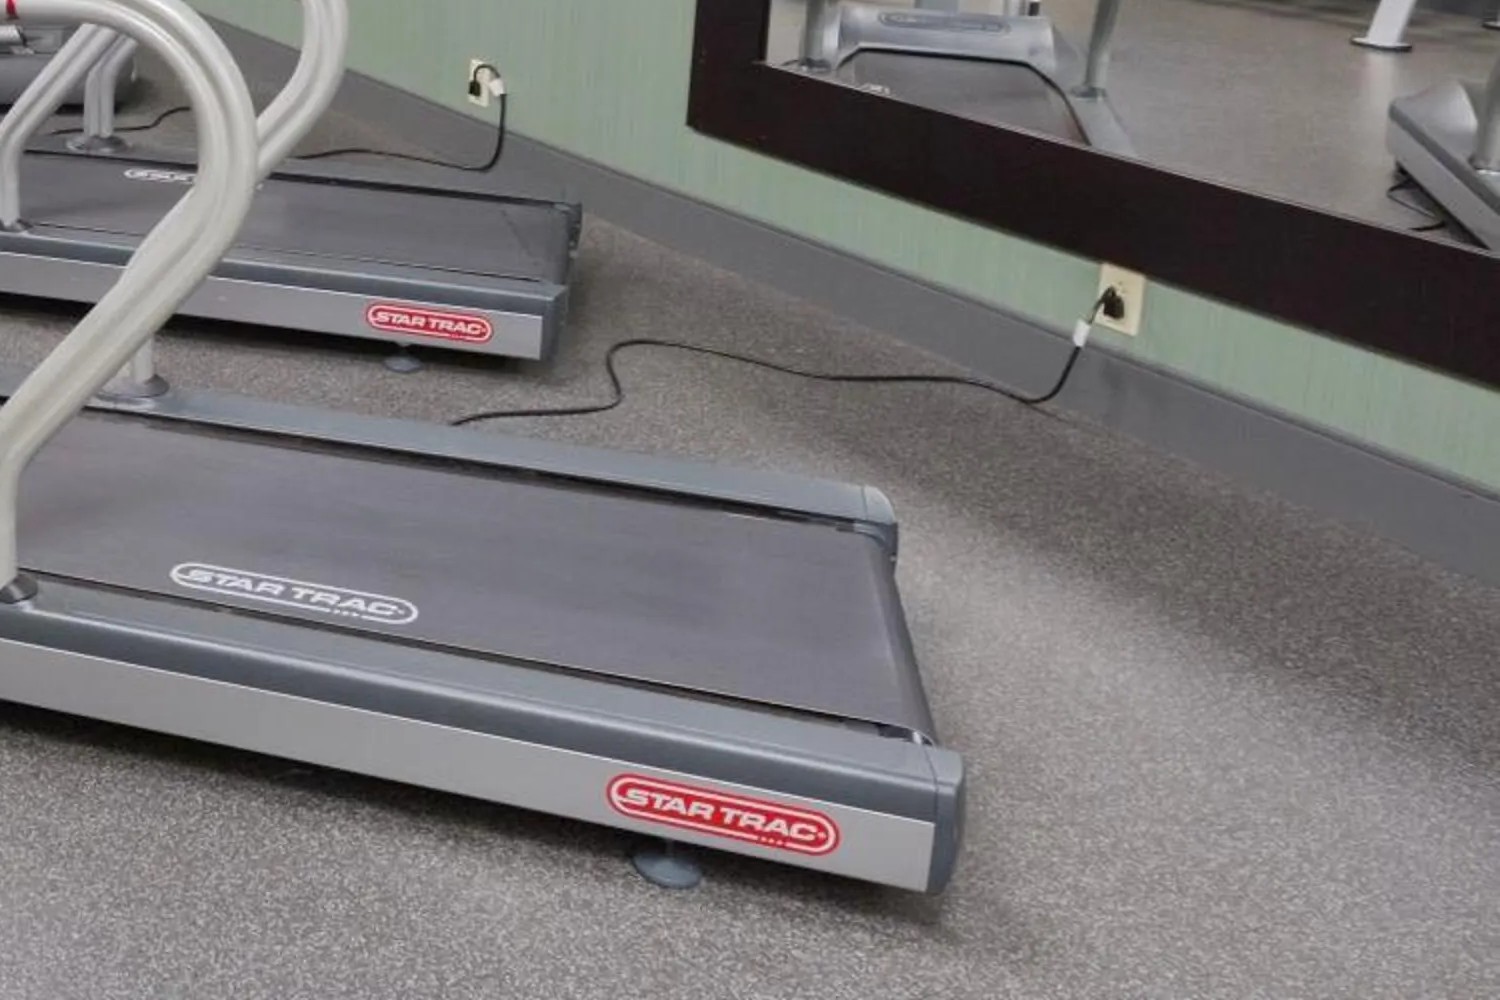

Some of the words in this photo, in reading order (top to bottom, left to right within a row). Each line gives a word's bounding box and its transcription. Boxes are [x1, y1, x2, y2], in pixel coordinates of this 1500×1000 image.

[375, 310, 426, 328] STAR
[428, 318, 482, 335] TRAC
[186, 568, 286, 596] STAR
[291, 586, 398, 617] TRAC
[625, 787, 716, 821] STAR
[718, 806, 819, 841] TRAC
